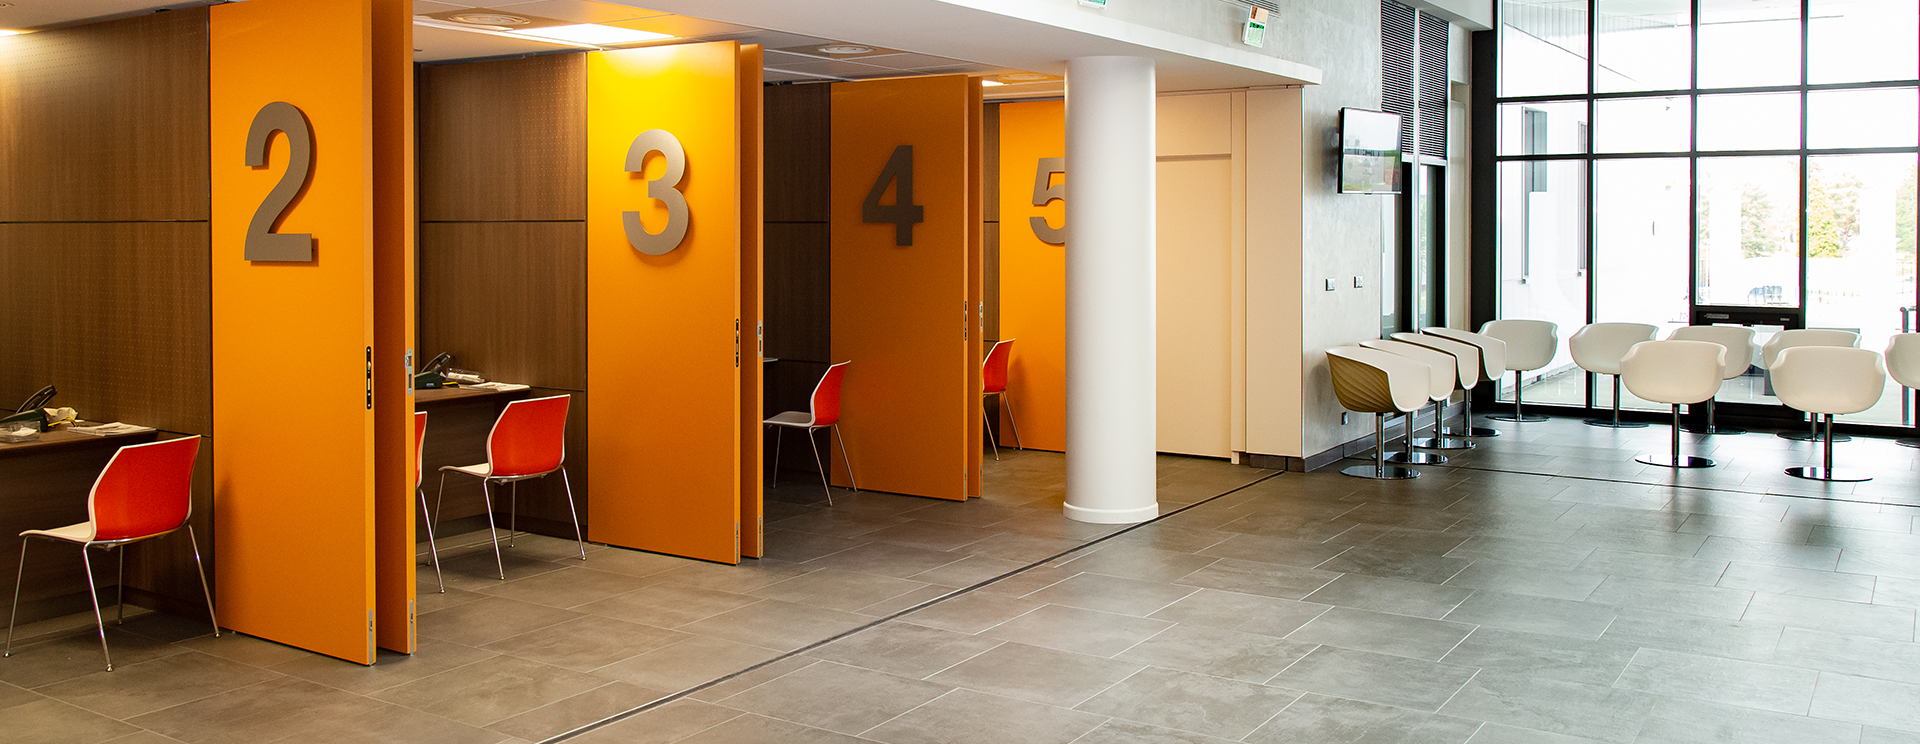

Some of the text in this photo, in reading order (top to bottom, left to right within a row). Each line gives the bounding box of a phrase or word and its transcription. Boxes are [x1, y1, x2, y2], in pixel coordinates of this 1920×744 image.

[244, 101, 313, 262] 2
[622, 129, 689, 256] 3
[862, 145, 924, 246] 4
[1029, 157, 1066, 245] 5
